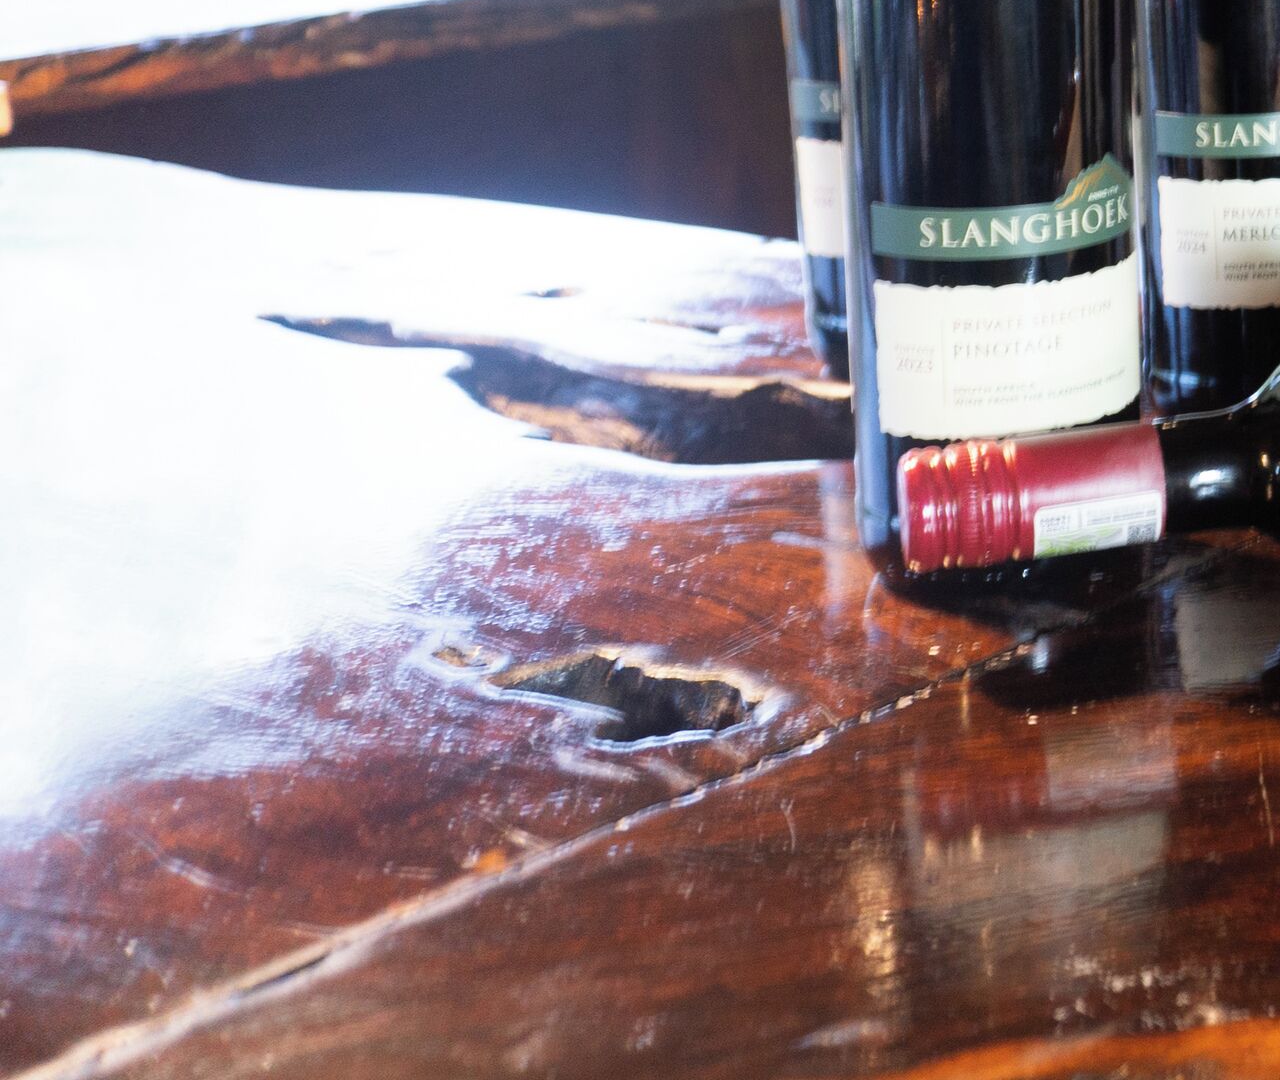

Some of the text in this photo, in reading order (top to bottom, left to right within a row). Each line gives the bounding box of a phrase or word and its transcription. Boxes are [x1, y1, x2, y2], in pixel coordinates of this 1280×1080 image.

[918, 192, 1129, 249] SLANGHOEK
[1222, 205, 1280, 220] PRIVATE
[952, 315, 1025, 333] PRIVATE
[952, 334, 1065, 361] PINOTAGE
